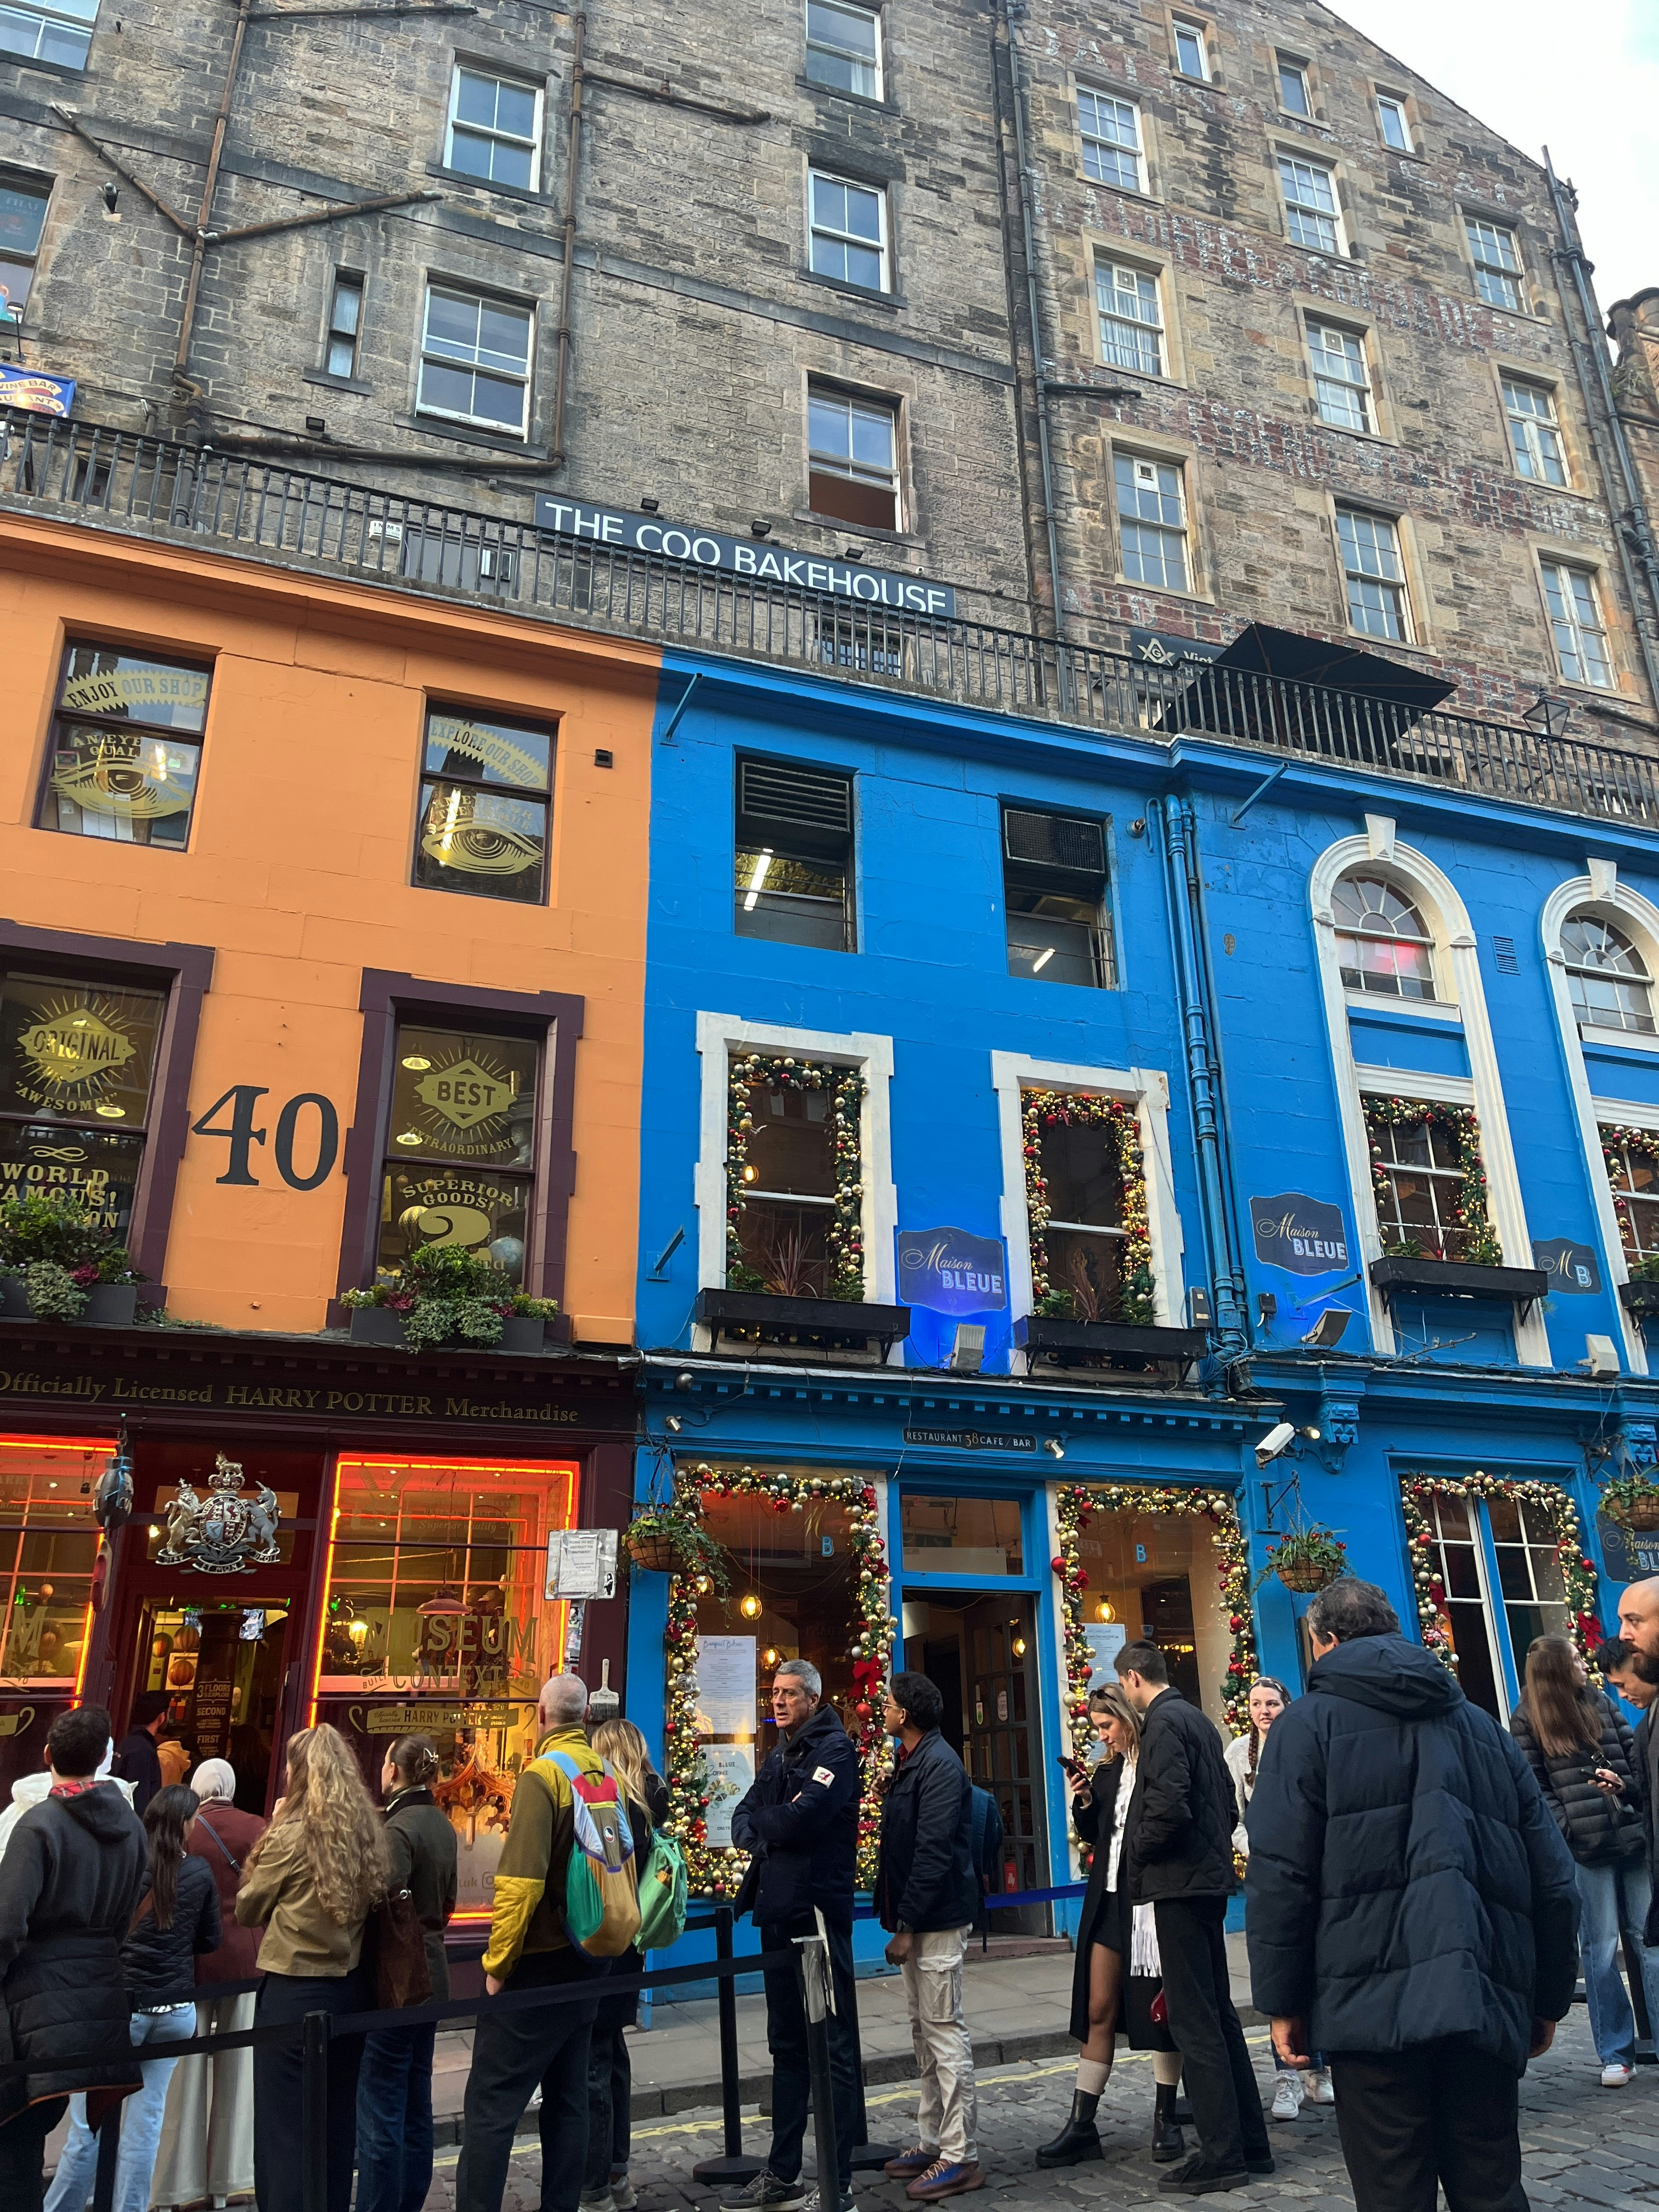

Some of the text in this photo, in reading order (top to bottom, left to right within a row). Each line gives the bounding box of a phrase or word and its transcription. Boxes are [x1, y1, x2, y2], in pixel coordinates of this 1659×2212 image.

[28, 380, 56, 391] BAR
[545, 501, 946, 613] THE COO BAKEHOUSE
[67, 678, 202, 709] ENJOY OUR SHOP
[74, 734, 141, 747] AN EYE
[89, 746, 138, 758] QUAL
[431, 721, 540, 785] EXPLORE OUR SHOP
[33, 1030, 120, 1060] ORIGINAL
[437, 1080, 496, 1107] BEST
[191, 1085, 339, 1192] 40
[1, 1162, 110, 1187] WORLD
[0, 1183, 117, 1207] AMOUS!
[402, 1179, 514, 1207] SUPERIOR
[422, 1192, 495, 1211] GOODS!
[1256, 1212, 1319, 1242] Maison
[901, 1242, 973, 1274] Maison
[1291, 1237, 1347, 1260] BLEUE
[941, 1269, 1002, 1294] BLEUE
[1574, 1264, 1592, 1288] B
[111, 1378, 213, 1403] Licensed
[224, 1385, 321, 1409] HARRY
[325, 1390, 433, 1415] POTTER
[444, 1397, 579, 1422] Merchandise
[906, 1431, 963, 1443] RESTAURANT
[965, 1432, 979, 1447] 38
[980, 1436, 1003, 1446] CAFE
[1013, 1438, 1031, 1448] BAR
[419, 1521, 461, 1531] Superior
[821, 1536, 834, 1558] B
[1135, 1543, 1147, 1563] B
[216, 1564, 238, 1572] MON
[196, 1684, 231, 1698] 3 FLOORS
[362, 1673, 387, 1689] BUILT
[196, 1707, 226, 1716] SECOND
[404, 1709, 440, 1723] HARRY
[197, 1735, 220, 1743] FIRST
